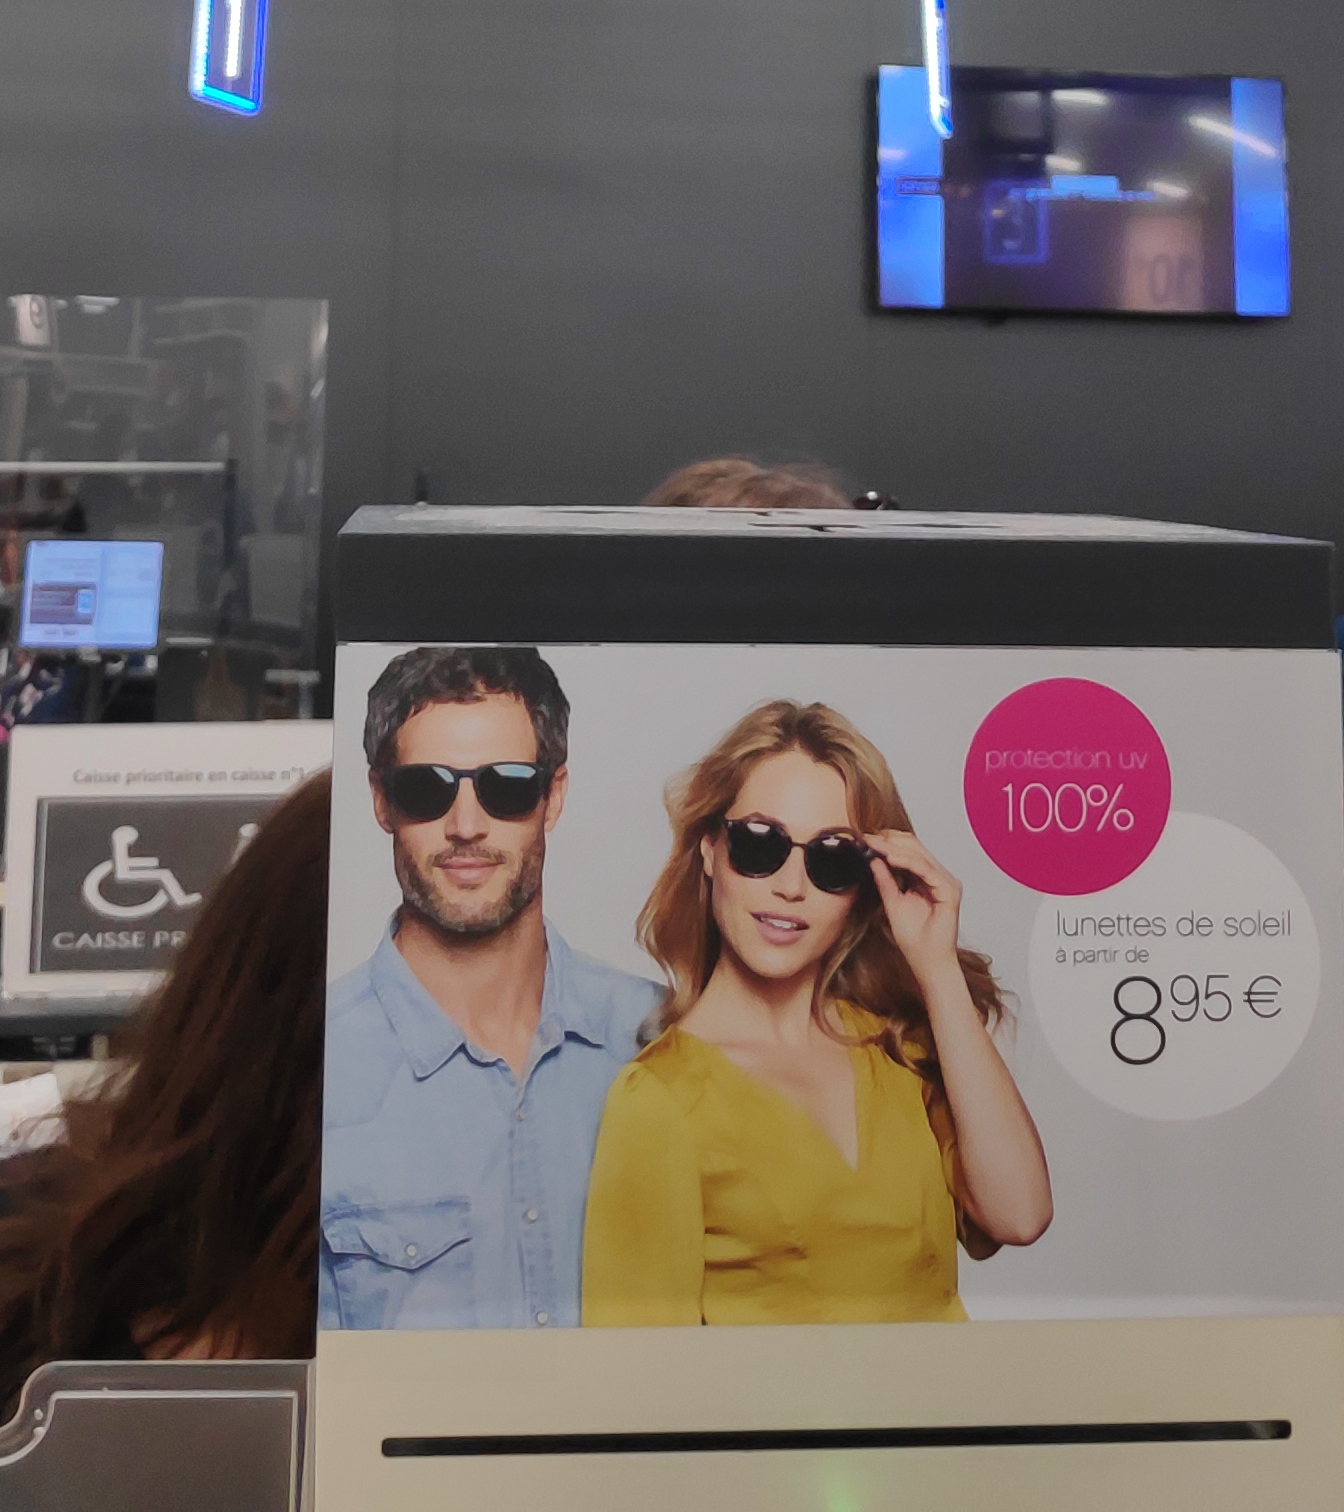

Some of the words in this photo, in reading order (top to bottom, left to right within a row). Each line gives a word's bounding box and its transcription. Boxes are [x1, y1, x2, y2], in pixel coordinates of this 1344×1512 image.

[985, 748, 1111, 773] protection
[1119, 751, 1148, 769] uv
[72, 768, 121, 784] Caisse
[125, 767, 203, 786] prioritaire
[1003, 782, 1134, 832] 100%
[1056, 910, 1166, 938] lunettes
[1176, 910, 1214, 938] de
[1222, 910, 1291, 938] soleil
[51, 930, 145, 949] CAISSE
[1056, 944, 1067, 964] à
[1073, 945, 1119, 966] partir
[1125, 944, 1149, 963] de
